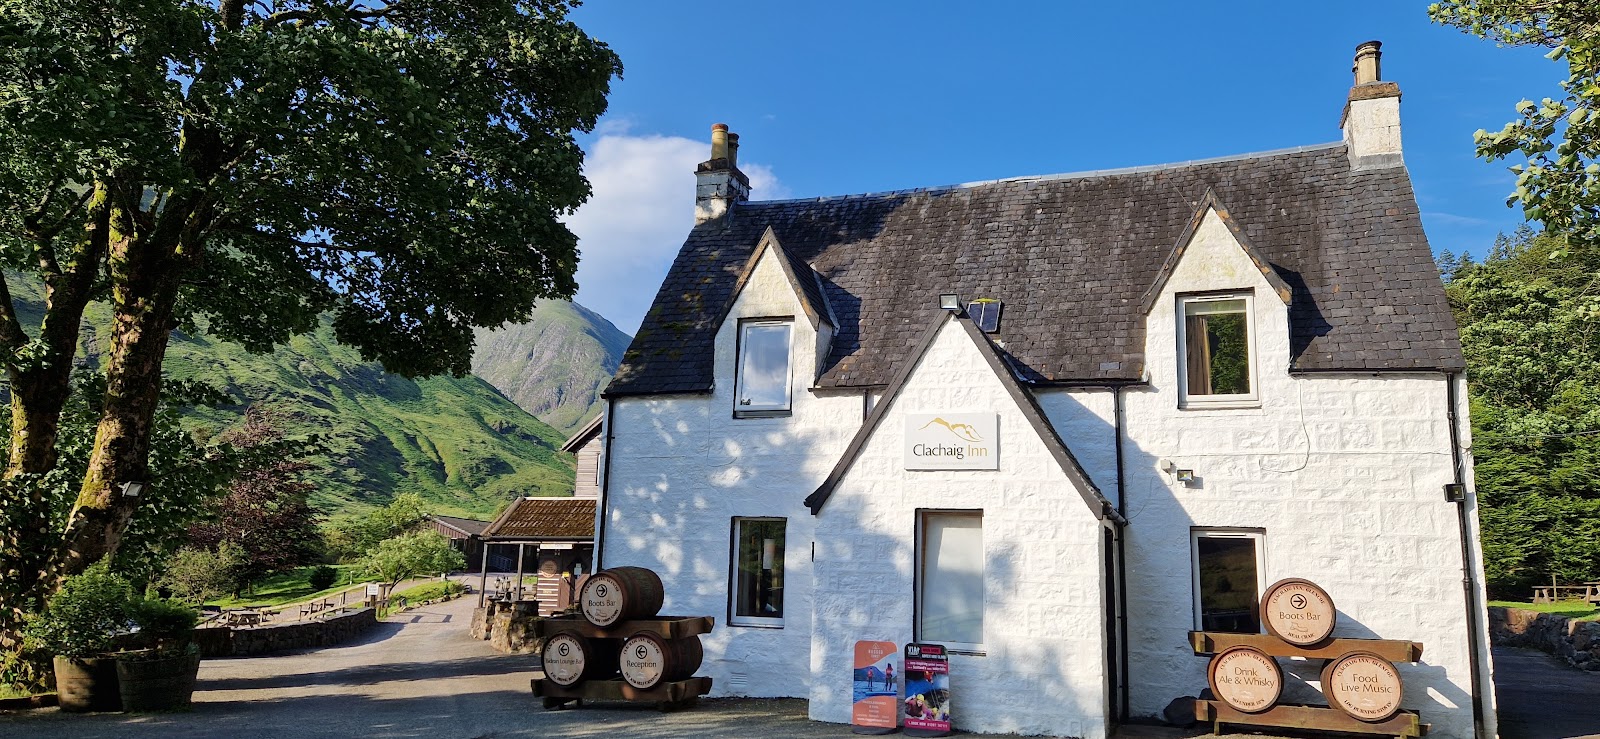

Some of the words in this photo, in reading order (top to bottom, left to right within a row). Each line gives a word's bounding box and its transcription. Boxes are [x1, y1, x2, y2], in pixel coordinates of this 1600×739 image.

[912, 443, 965, 460] Clachaig
[967, 444, 988, 457] Inn
[588, 599, 605, 607] Boots
[606, 599, 616, 607] Bar
[1279, 611, 1305, 620] Boots
[1306, 612, 1321, 621] Bar
[626, 660, 657, 670] Reception
[1234, 667, 1258, 676] Drink
[1219, 675, 1233, 684] Ale
[1234, 677, 1242, 685] &
[1243, 677, 1275, 689] Whisky
[1352, 673, 1378, 683] Food
[1341, 683, 1360, 692] Live
[1362, 684, 1393, 694] Music
